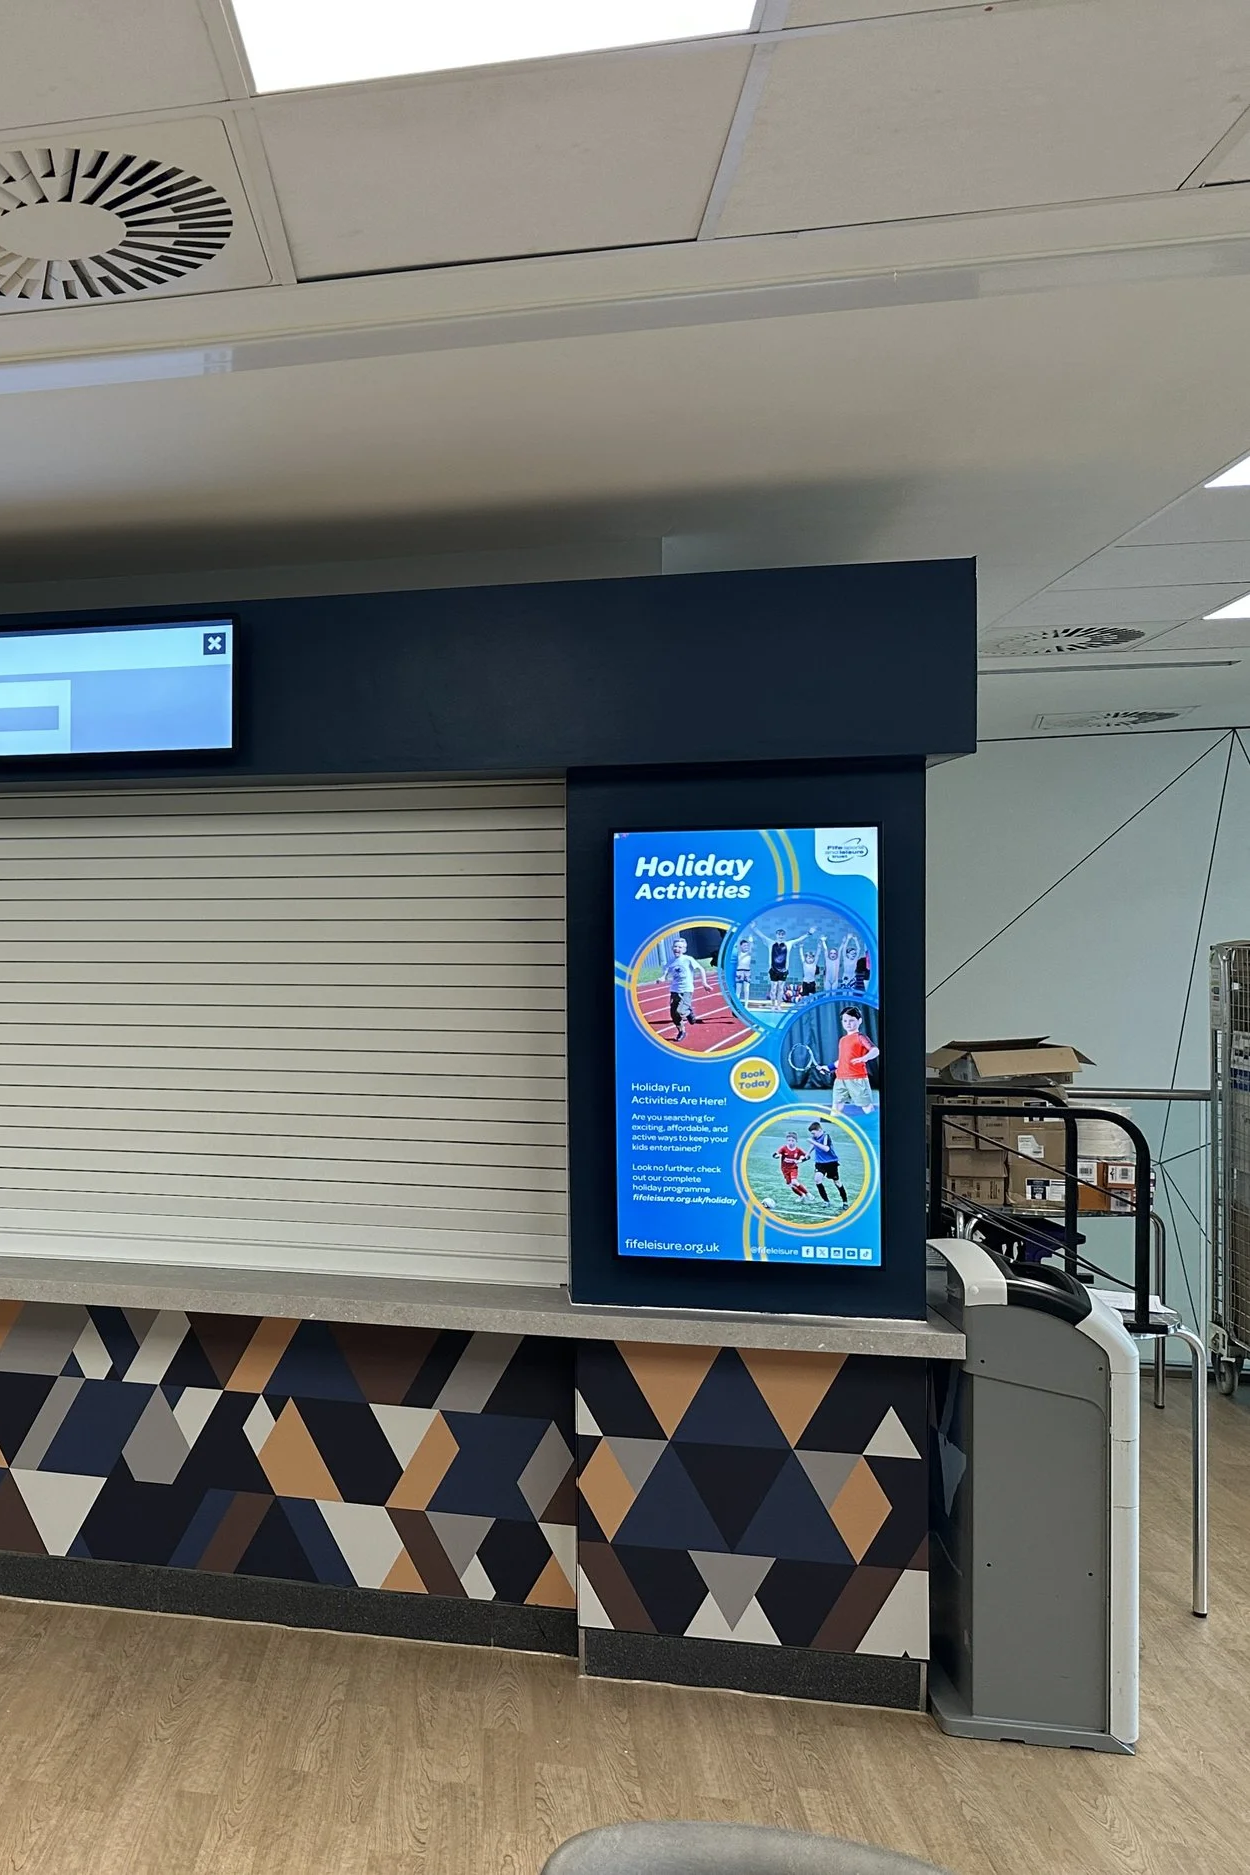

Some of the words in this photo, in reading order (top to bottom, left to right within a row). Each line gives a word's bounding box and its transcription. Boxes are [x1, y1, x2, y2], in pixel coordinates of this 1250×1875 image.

[635, 853, 754, 882] Holiday
[635, 880, 751, 900] Activities
[740, 1069, 766, 1079] Book
[631, 1082, 670, 1093] Holiday
[671, 1083, 691, 1092] Fun
[739, 1079, 771, 1090] Today
[631, 1095, 679, 1105] Activities
[680, 1096, 698, 1105] Are
[699, 1097, 727, 1106] Here!
[663, 1114, 703, 1123] searching
[703, 1114, 716, 1122] for
[631, 1124, 666, 1132] exciting,
[666, 1124, 711, 1132] affordable,
[689, 1135, 709, 1143] keep
[632, 1143, 648, 1151] kids
[649, 1144, 702, 1152] entertained?
[632, 1163, 652, 1171] Look
[696, 1165, 721, 1173] check
[662, 1175, 702, 1183] complete
[632, 1184, 662, 1192] holiday
[663, 1186, 711, 1194] programme
[633, 1193, 738, 1206] fifeleisure.org.uk/holiday
[625, 1238, 720, 1254] fifeleisure.org.uk
[750, 1246, 799, 1256] @fifeleisure
